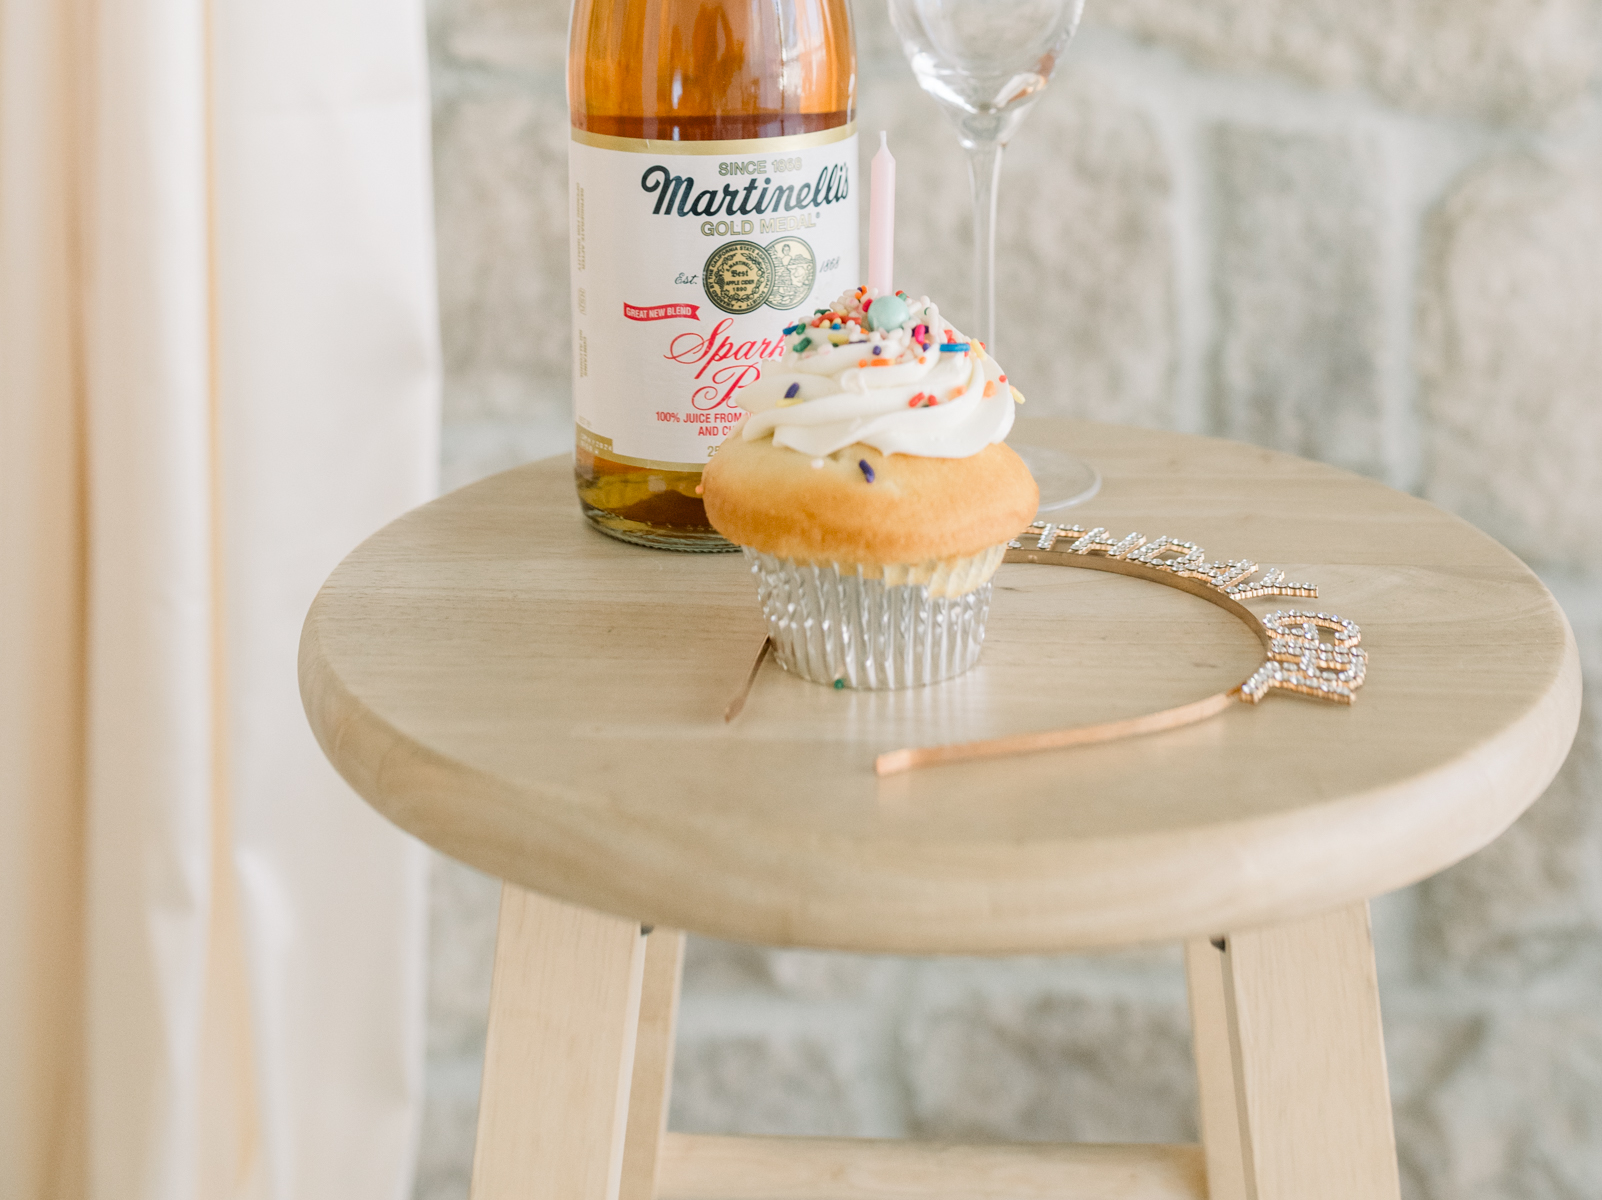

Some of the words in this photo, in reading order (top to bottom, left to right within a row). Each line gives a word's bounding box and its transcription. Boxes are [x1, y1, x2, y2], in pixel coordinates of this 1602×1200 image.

[718, 160, 767, 176] SINCE
[771, 157, 802, 173] 1868
[641, 162, 849, 217] Martinelli's
[700, 220, 754, 236] GOLD
[711, 246, 738, 267] CALIFORNIA
[674, 272, 699, 285] Est.
[626, 307, 648, 319] GREAT
[648, 308, 666, 318] NEW
[666, 307, 692, 316] BLEND
[663, 318, 793, 380] Spark
[656, 411, 680, 423] 100%
[683, 413, 711, 423] JUICE
[714, 412, 742, 423] FROM
[698, 426, 719, 436] AND
[1007, 520, 1319, 600] THDAY
